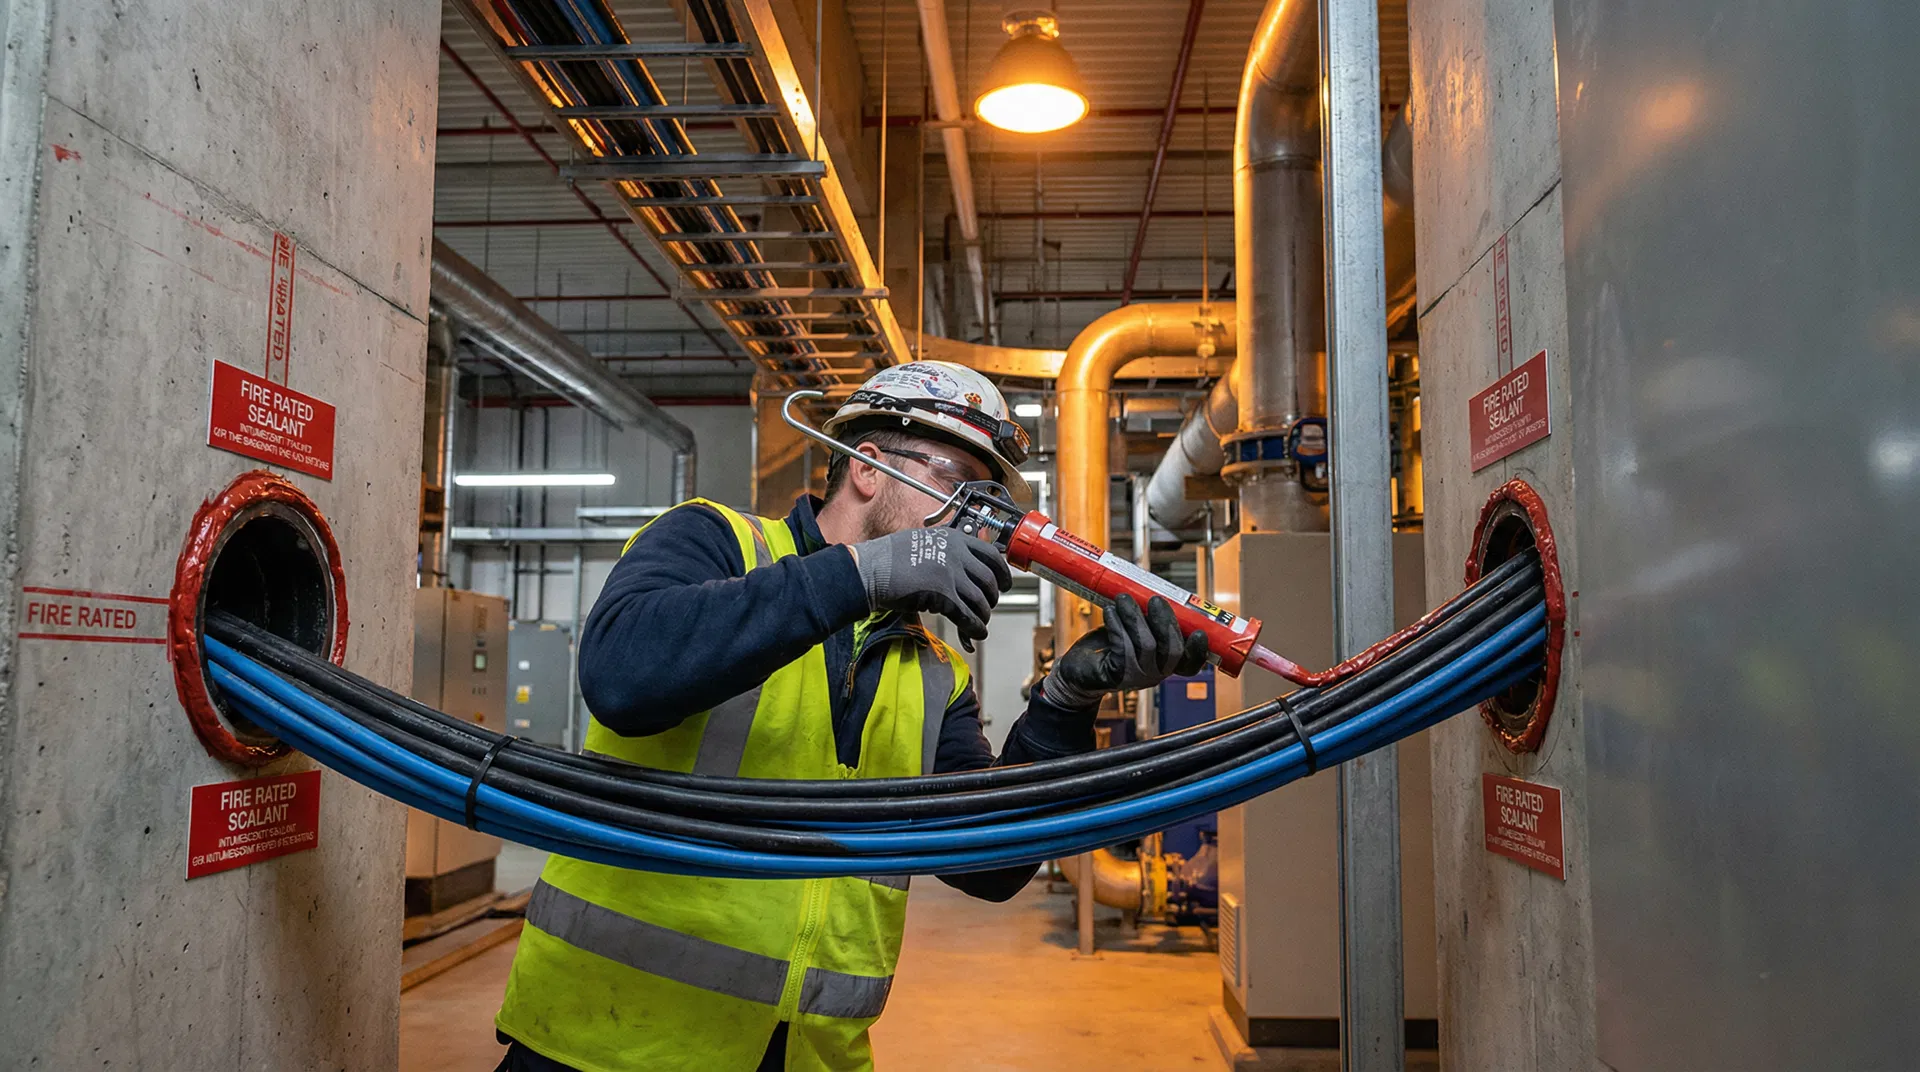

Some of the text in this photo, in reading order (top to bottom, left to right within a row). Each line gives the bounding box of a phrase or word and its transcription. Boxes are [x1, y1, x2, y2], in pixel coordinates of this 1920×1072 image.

[241, 379, 314, 422] FIRE RATED
[1483, 371, 1529, 415] FIRE RATED
[248, 404, 306, 438] SEALANT
[1489, 395, 1524, 431] SEALANT
[27, 602, 137, 629] FIRE RATED
[221, 782, 297, 811] FIRE RATED
[1495, 785, 1544, 813] FIRE RATED
[228, 804, 289, 831] SCALANT
